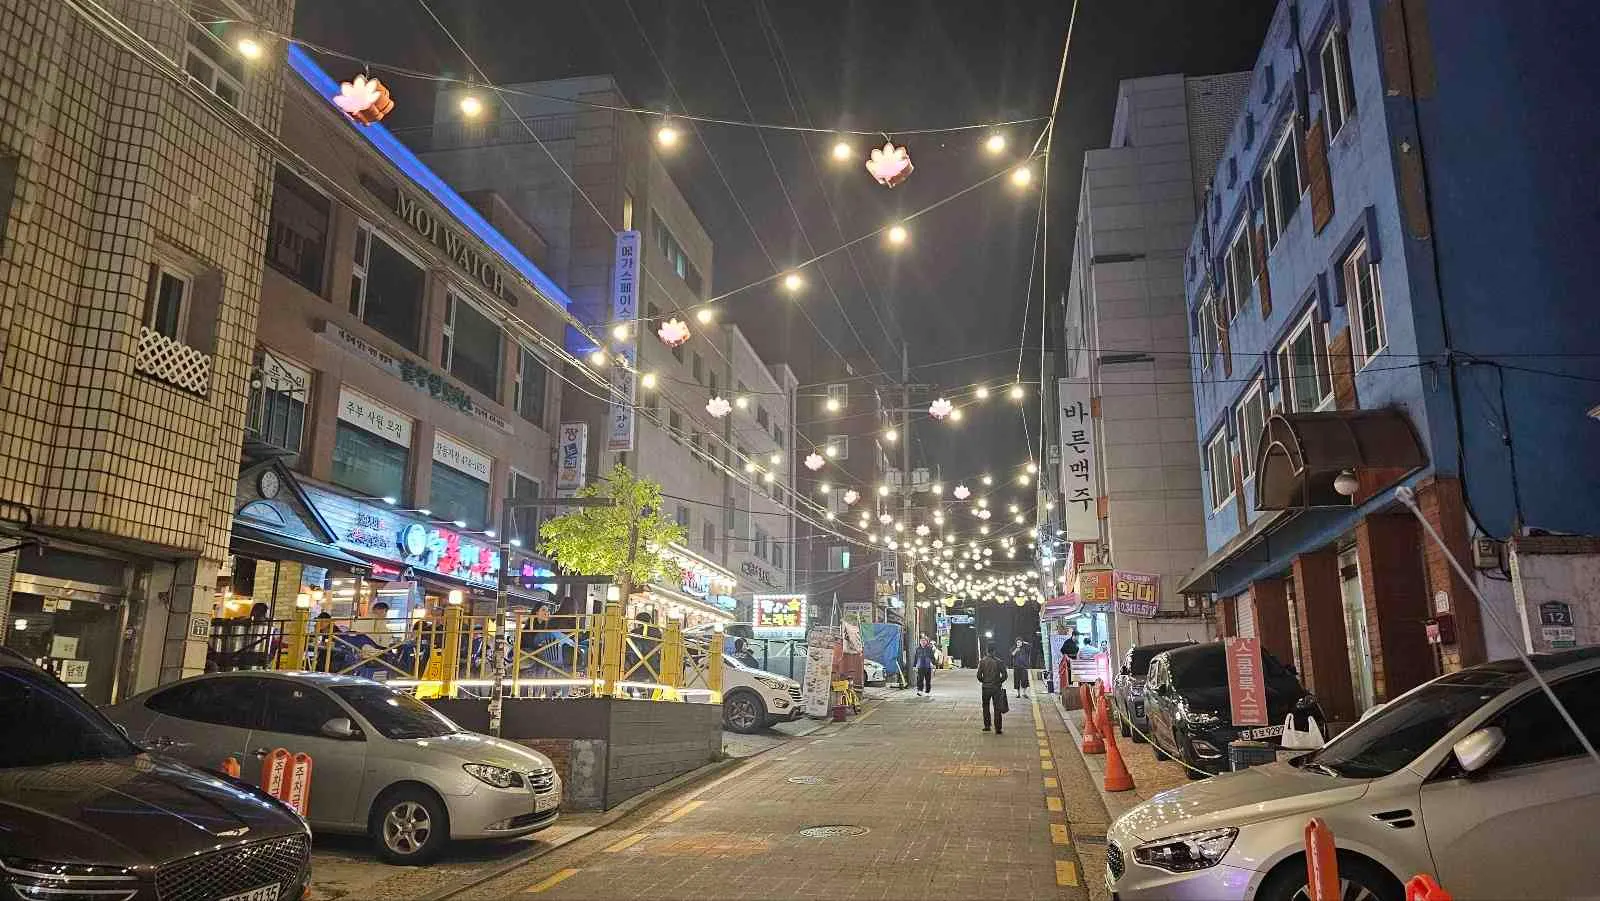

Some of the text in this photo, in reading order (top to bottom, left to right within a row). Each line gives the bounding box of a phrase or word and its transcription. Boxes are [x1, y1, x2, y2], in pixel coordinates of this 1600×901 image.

[395, 187, 504, 299] MOI WATCH
[620, 246, 633, 318] 메가스페이스
[346, 400, 402, 438] 주부 사원 모집
[1063, 401, 1094, 512] 바른맥주
[1116, 580, 1155, 603] 임대
[1549, 612, 1565, 623] 12
